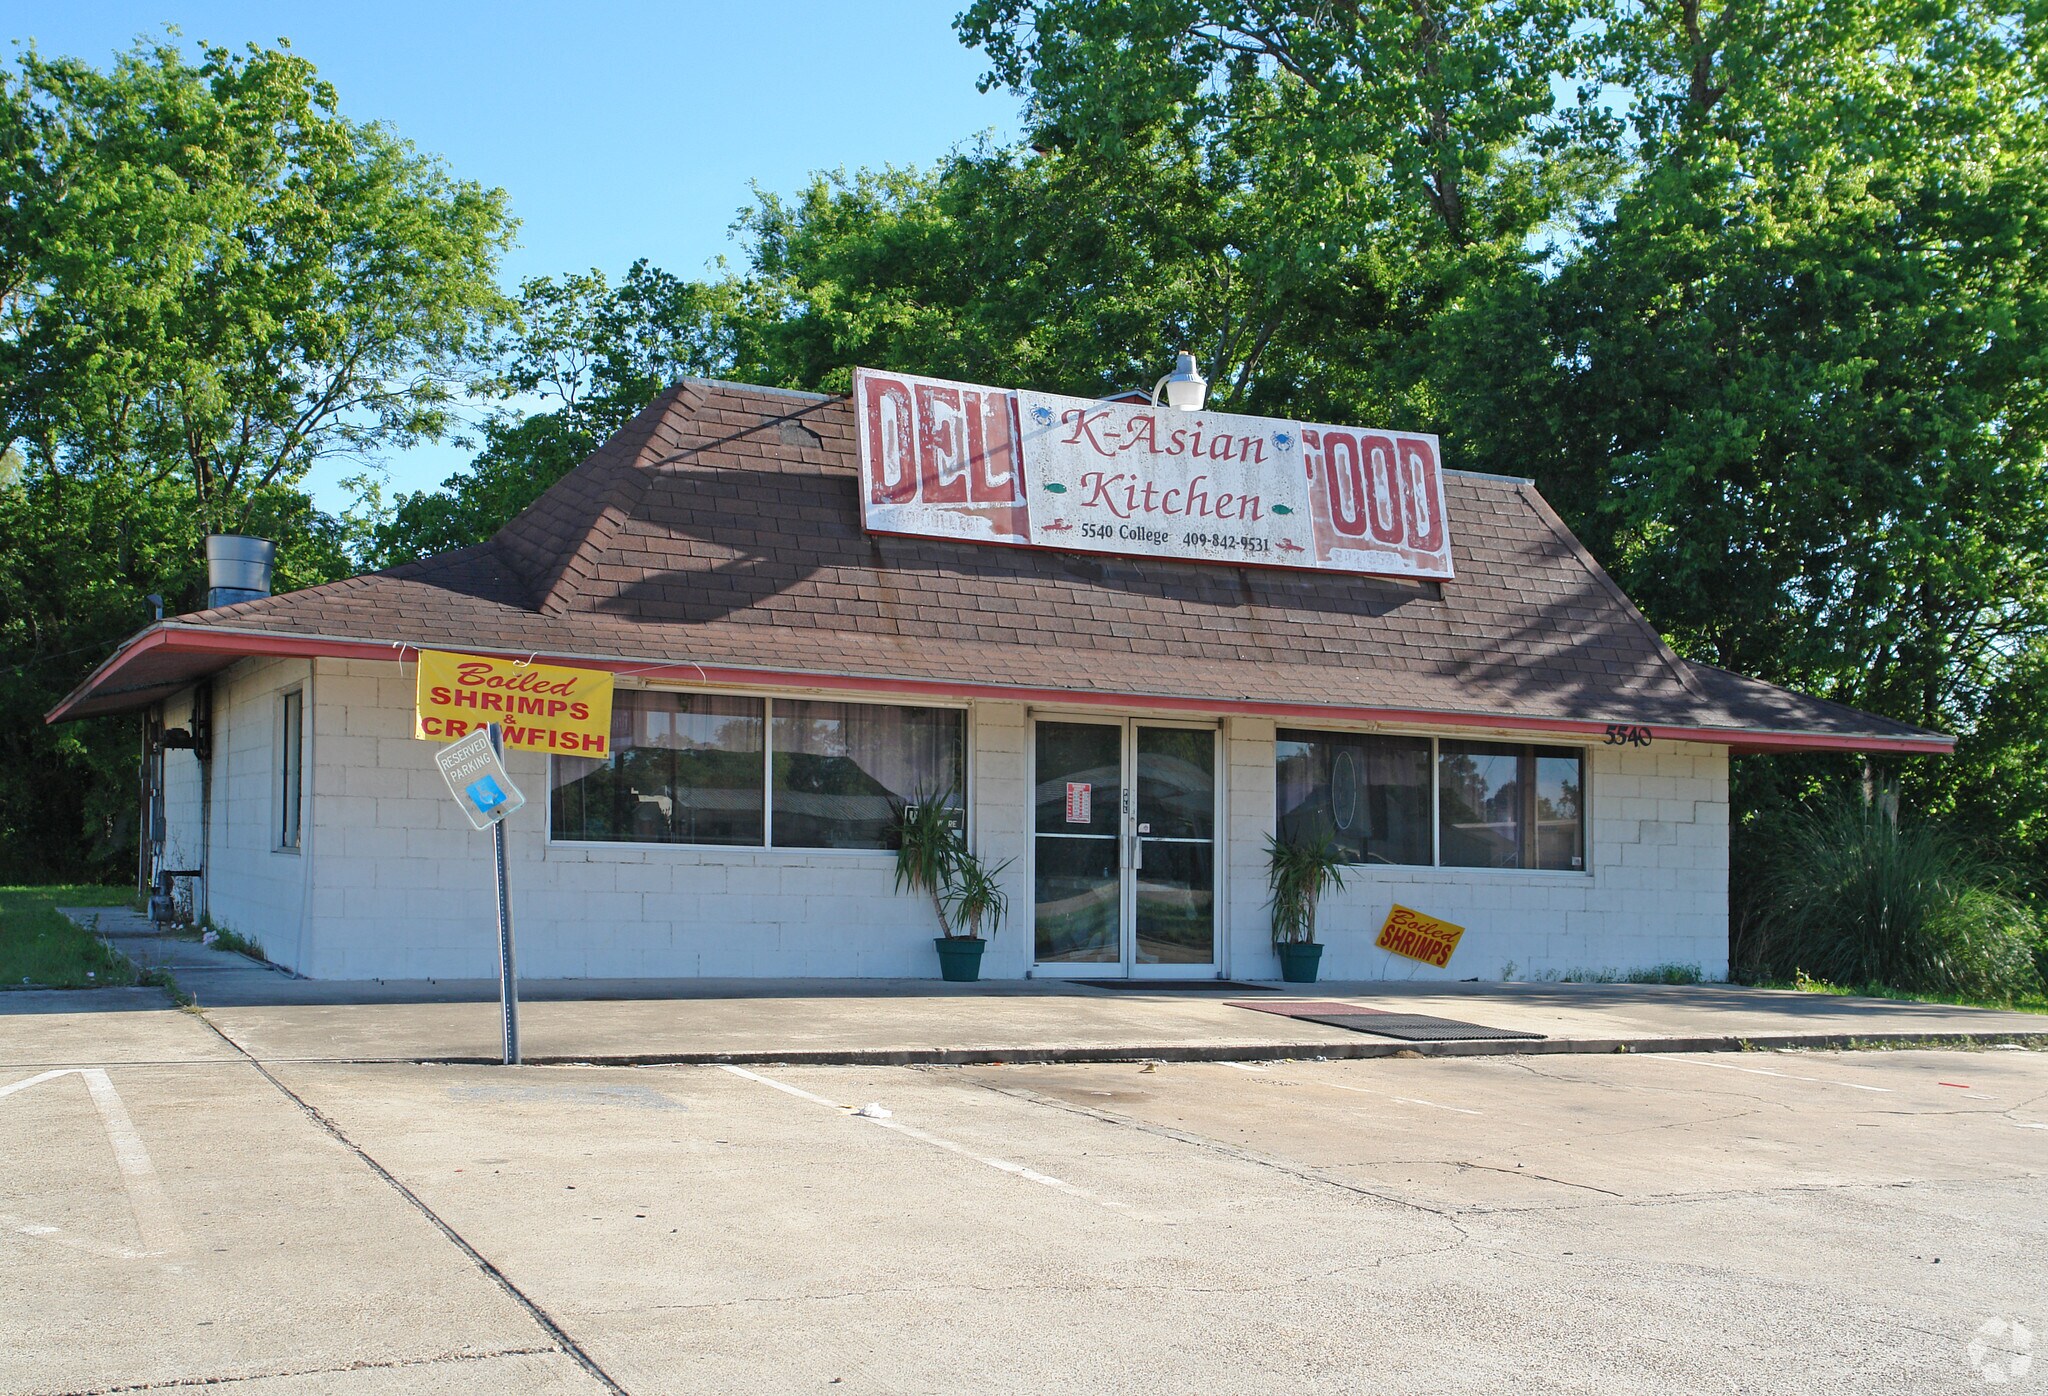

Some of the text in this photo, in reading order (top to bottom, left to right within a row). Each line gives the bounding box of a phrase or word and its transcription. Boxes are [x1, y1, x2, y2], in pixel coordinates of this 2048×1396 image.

[1061, 408, 1268, 464] K-Asian
[1080, 471, 1265, 521] Kitchen
[1081, 523, 1270, 552] 5540 College 409-842-9531
[456, 662, 578, 697] Boiled
[430, 686, 590, 721] SHRIMPS
[503, 714, 518, 725] &
[1603, 724, 1652, 748] 5540
[440, 738, 487, 771] RESERVED
[450, 752, 491, 783] PARKING
[1391, 909, 1461, 943] Boiled
[1380, 923, 1452, 966] SHRIMPS
